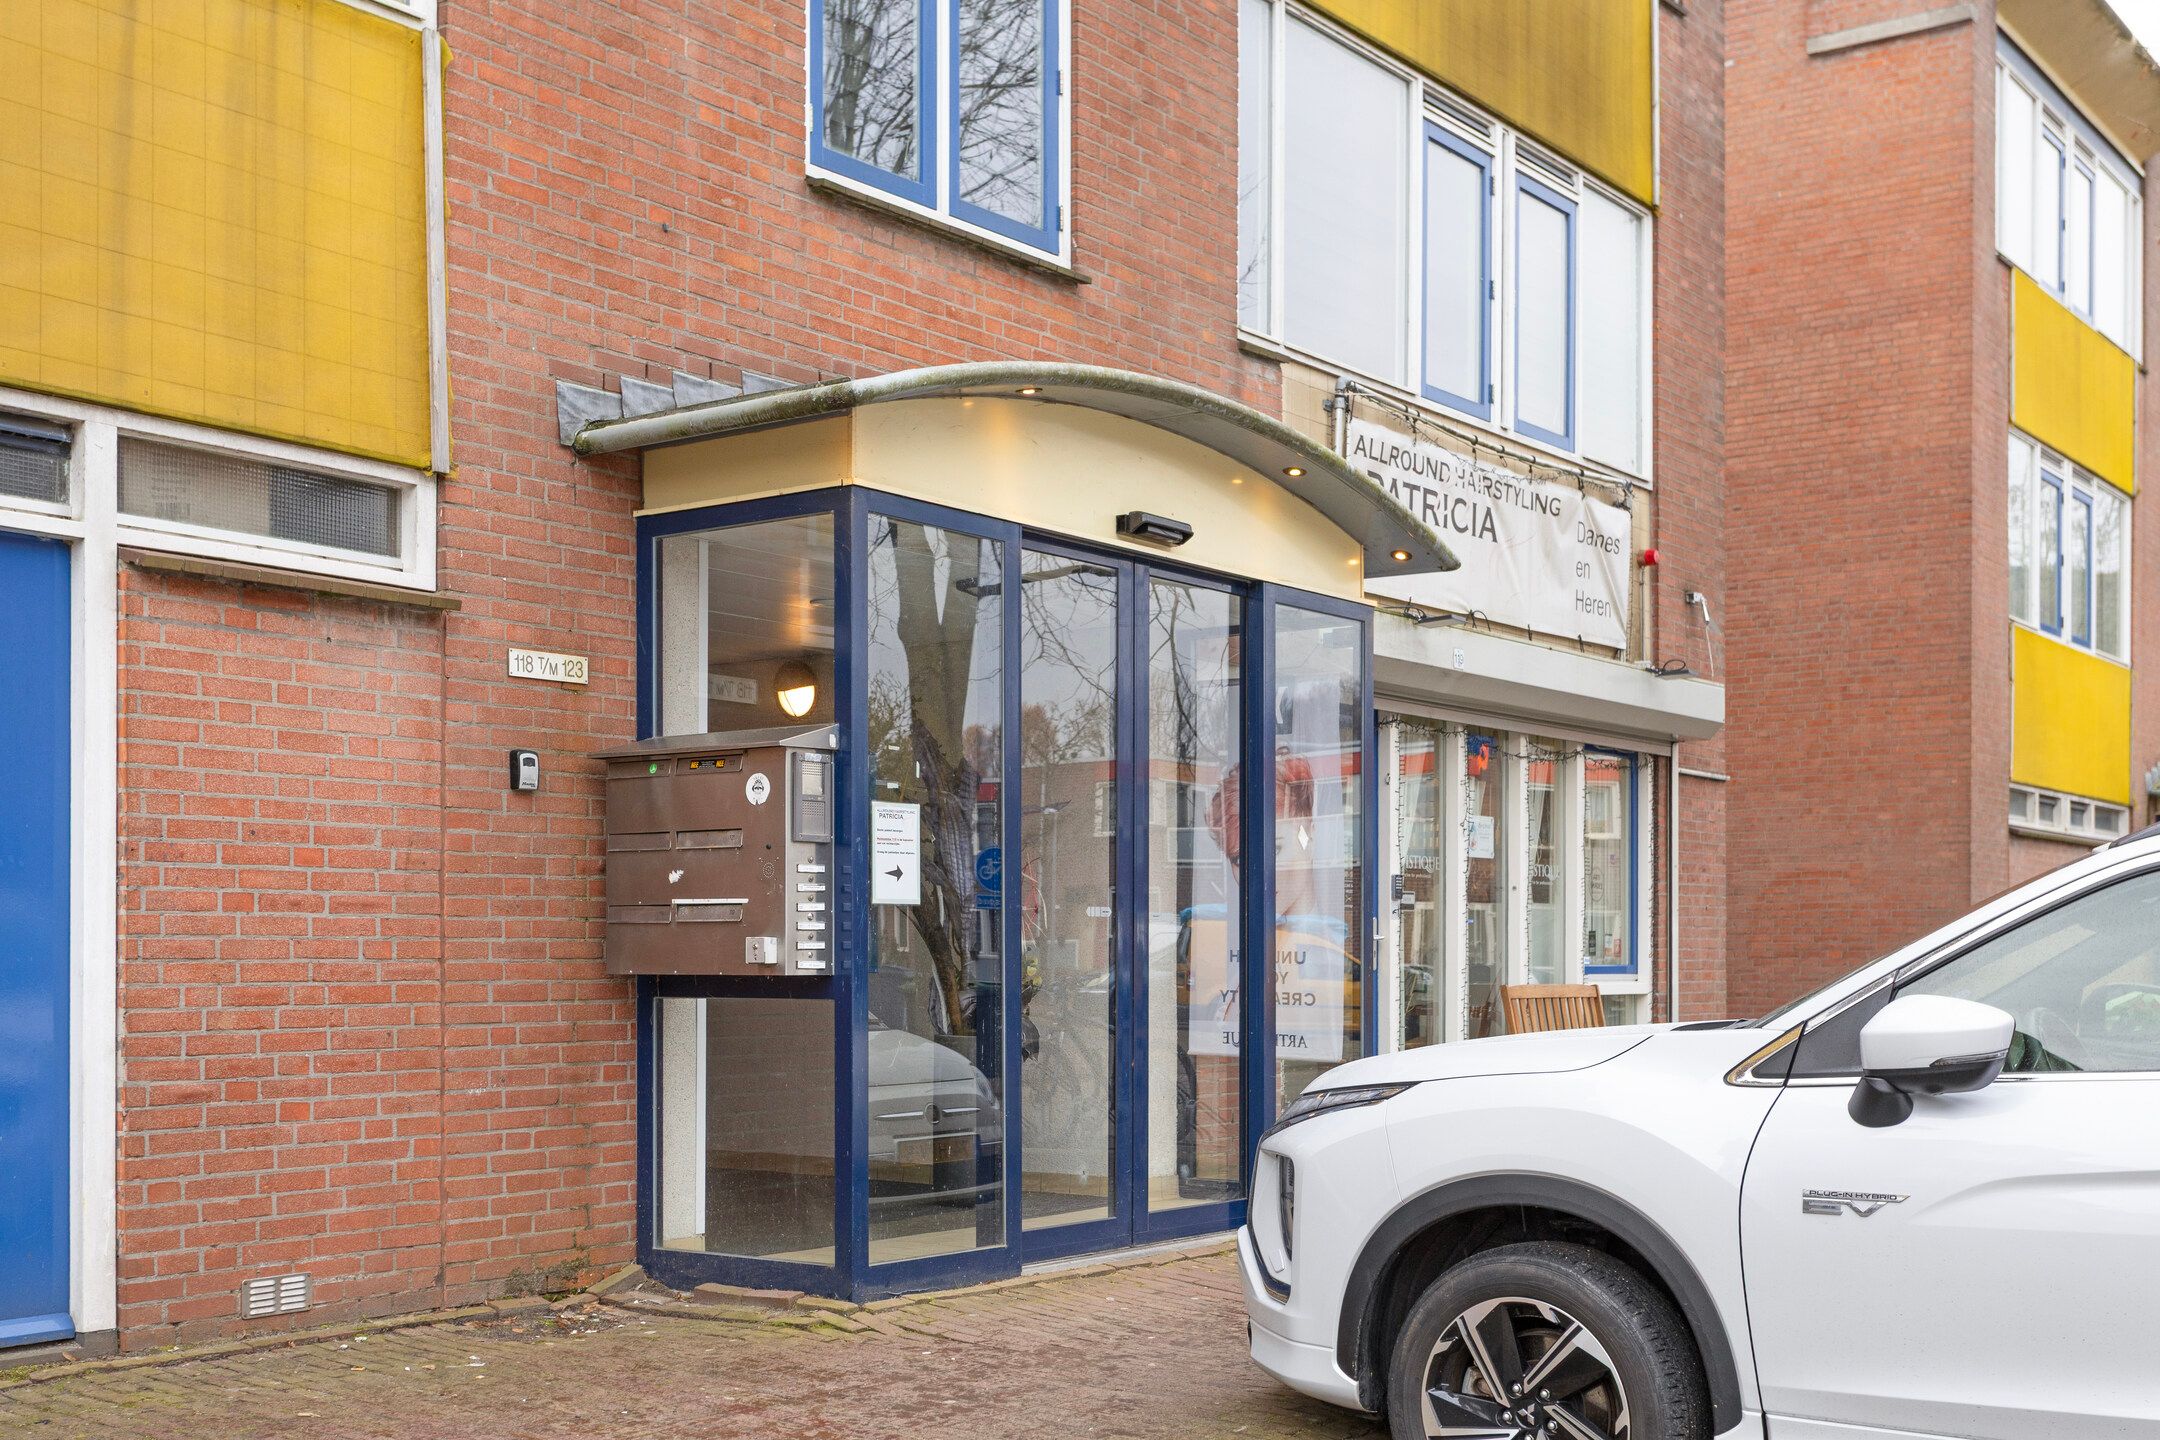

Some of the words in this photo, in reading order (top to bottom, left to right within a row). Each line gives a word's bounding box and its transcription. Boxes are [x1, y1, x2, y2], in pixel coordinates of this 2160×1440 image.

[1354, 435, 1450, 483] ALLROUND
[1455, 466, 1562, 517] HAIRSTYLING
[1576, 561, 1591, 579] en
[1575, 589, 1611, 618] Heren
[514, 654, 534, 673] 118
[538, 656, 558, 676] T/M
[562, 660, 584, 678] 123
[879, 812, 904, 820] PATRICIA
[1809, 1190, 1853, 1199] PLUG-IN
[1855, 1193, 1898, 1201] HYBRID
